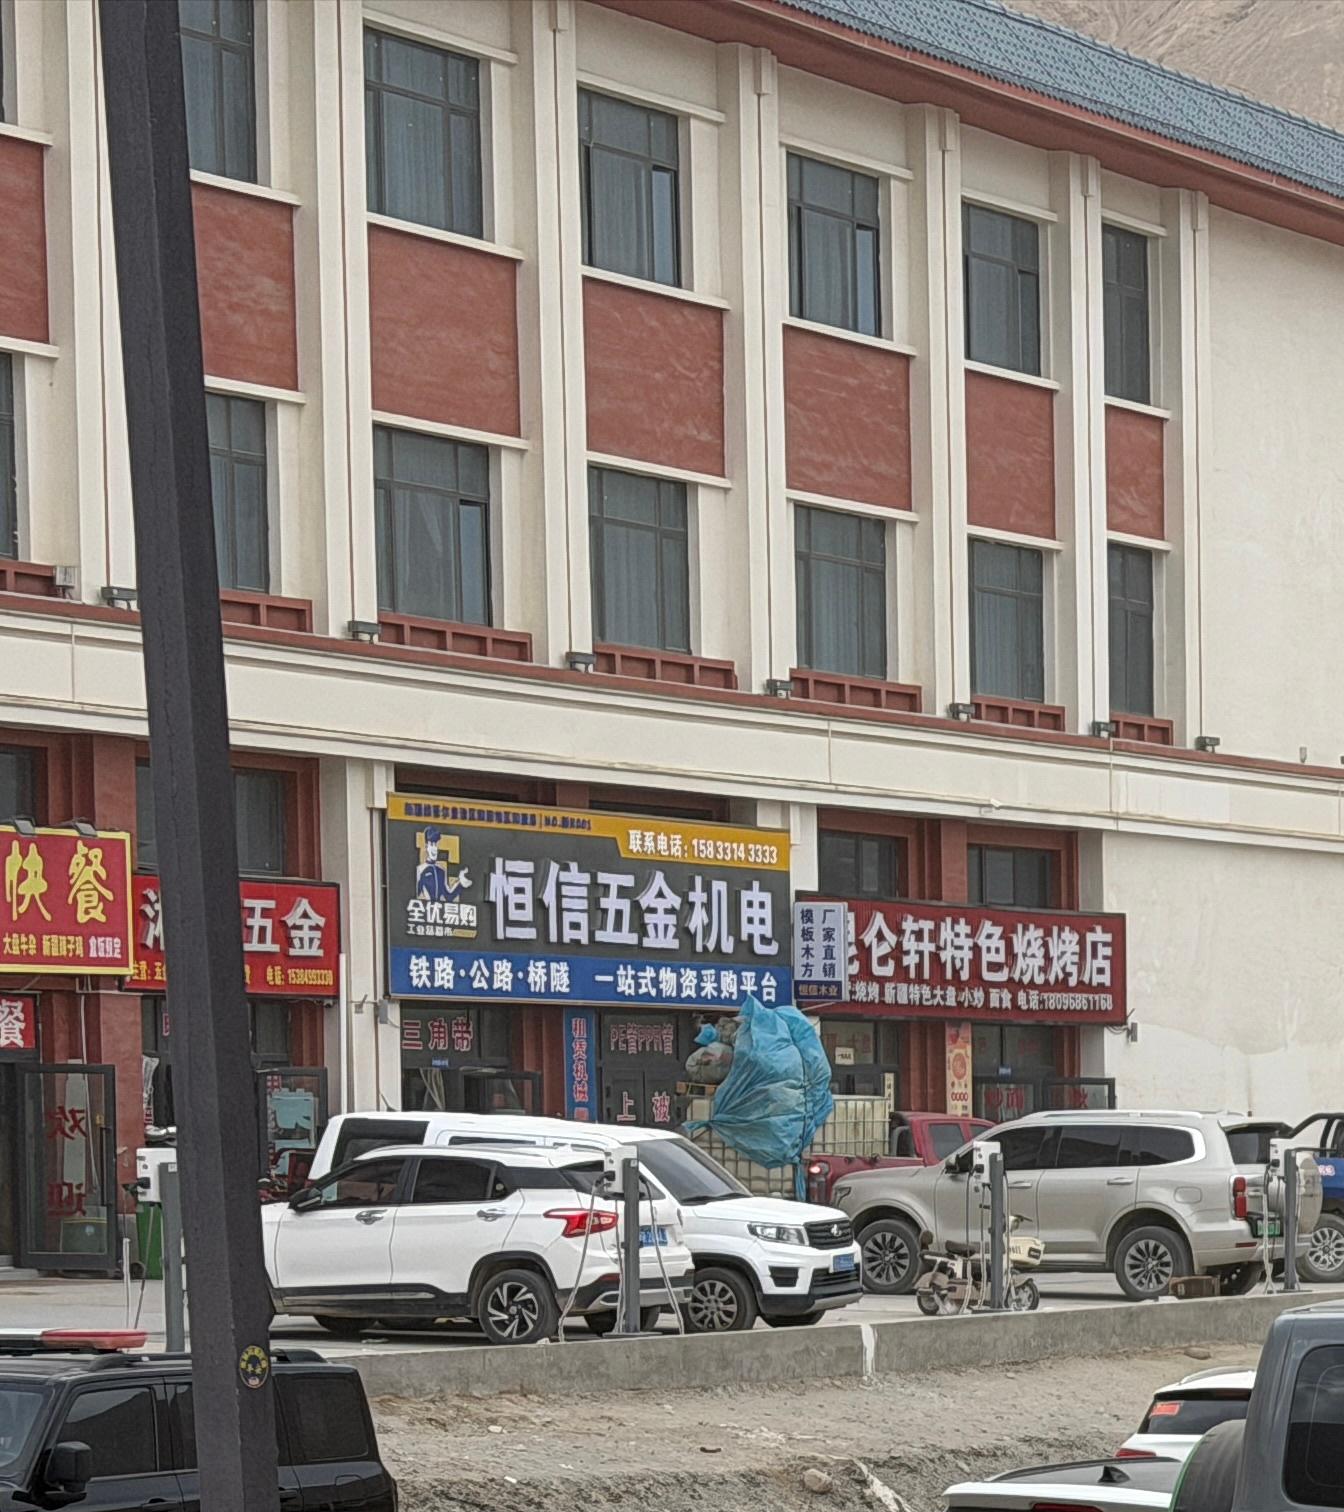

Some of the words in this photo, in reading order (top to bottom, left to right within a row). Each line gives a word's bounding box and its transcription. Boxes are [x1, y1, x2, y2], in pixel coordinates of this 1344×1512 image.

[5, 839, 114, 924] 快餐
[407, 899, 477, 927] 全优易购
[488, 857, 778, 956] 恒信五金机电
[243, 898, 326, 957] 五金
[800, 908, 815, 979] 模板木方
[821, 908, 836, 979] 厂家直销
[594, 964, 778, 1003] 一站式物资采购平台
[401, 1016, 474, 1052] 三角带
